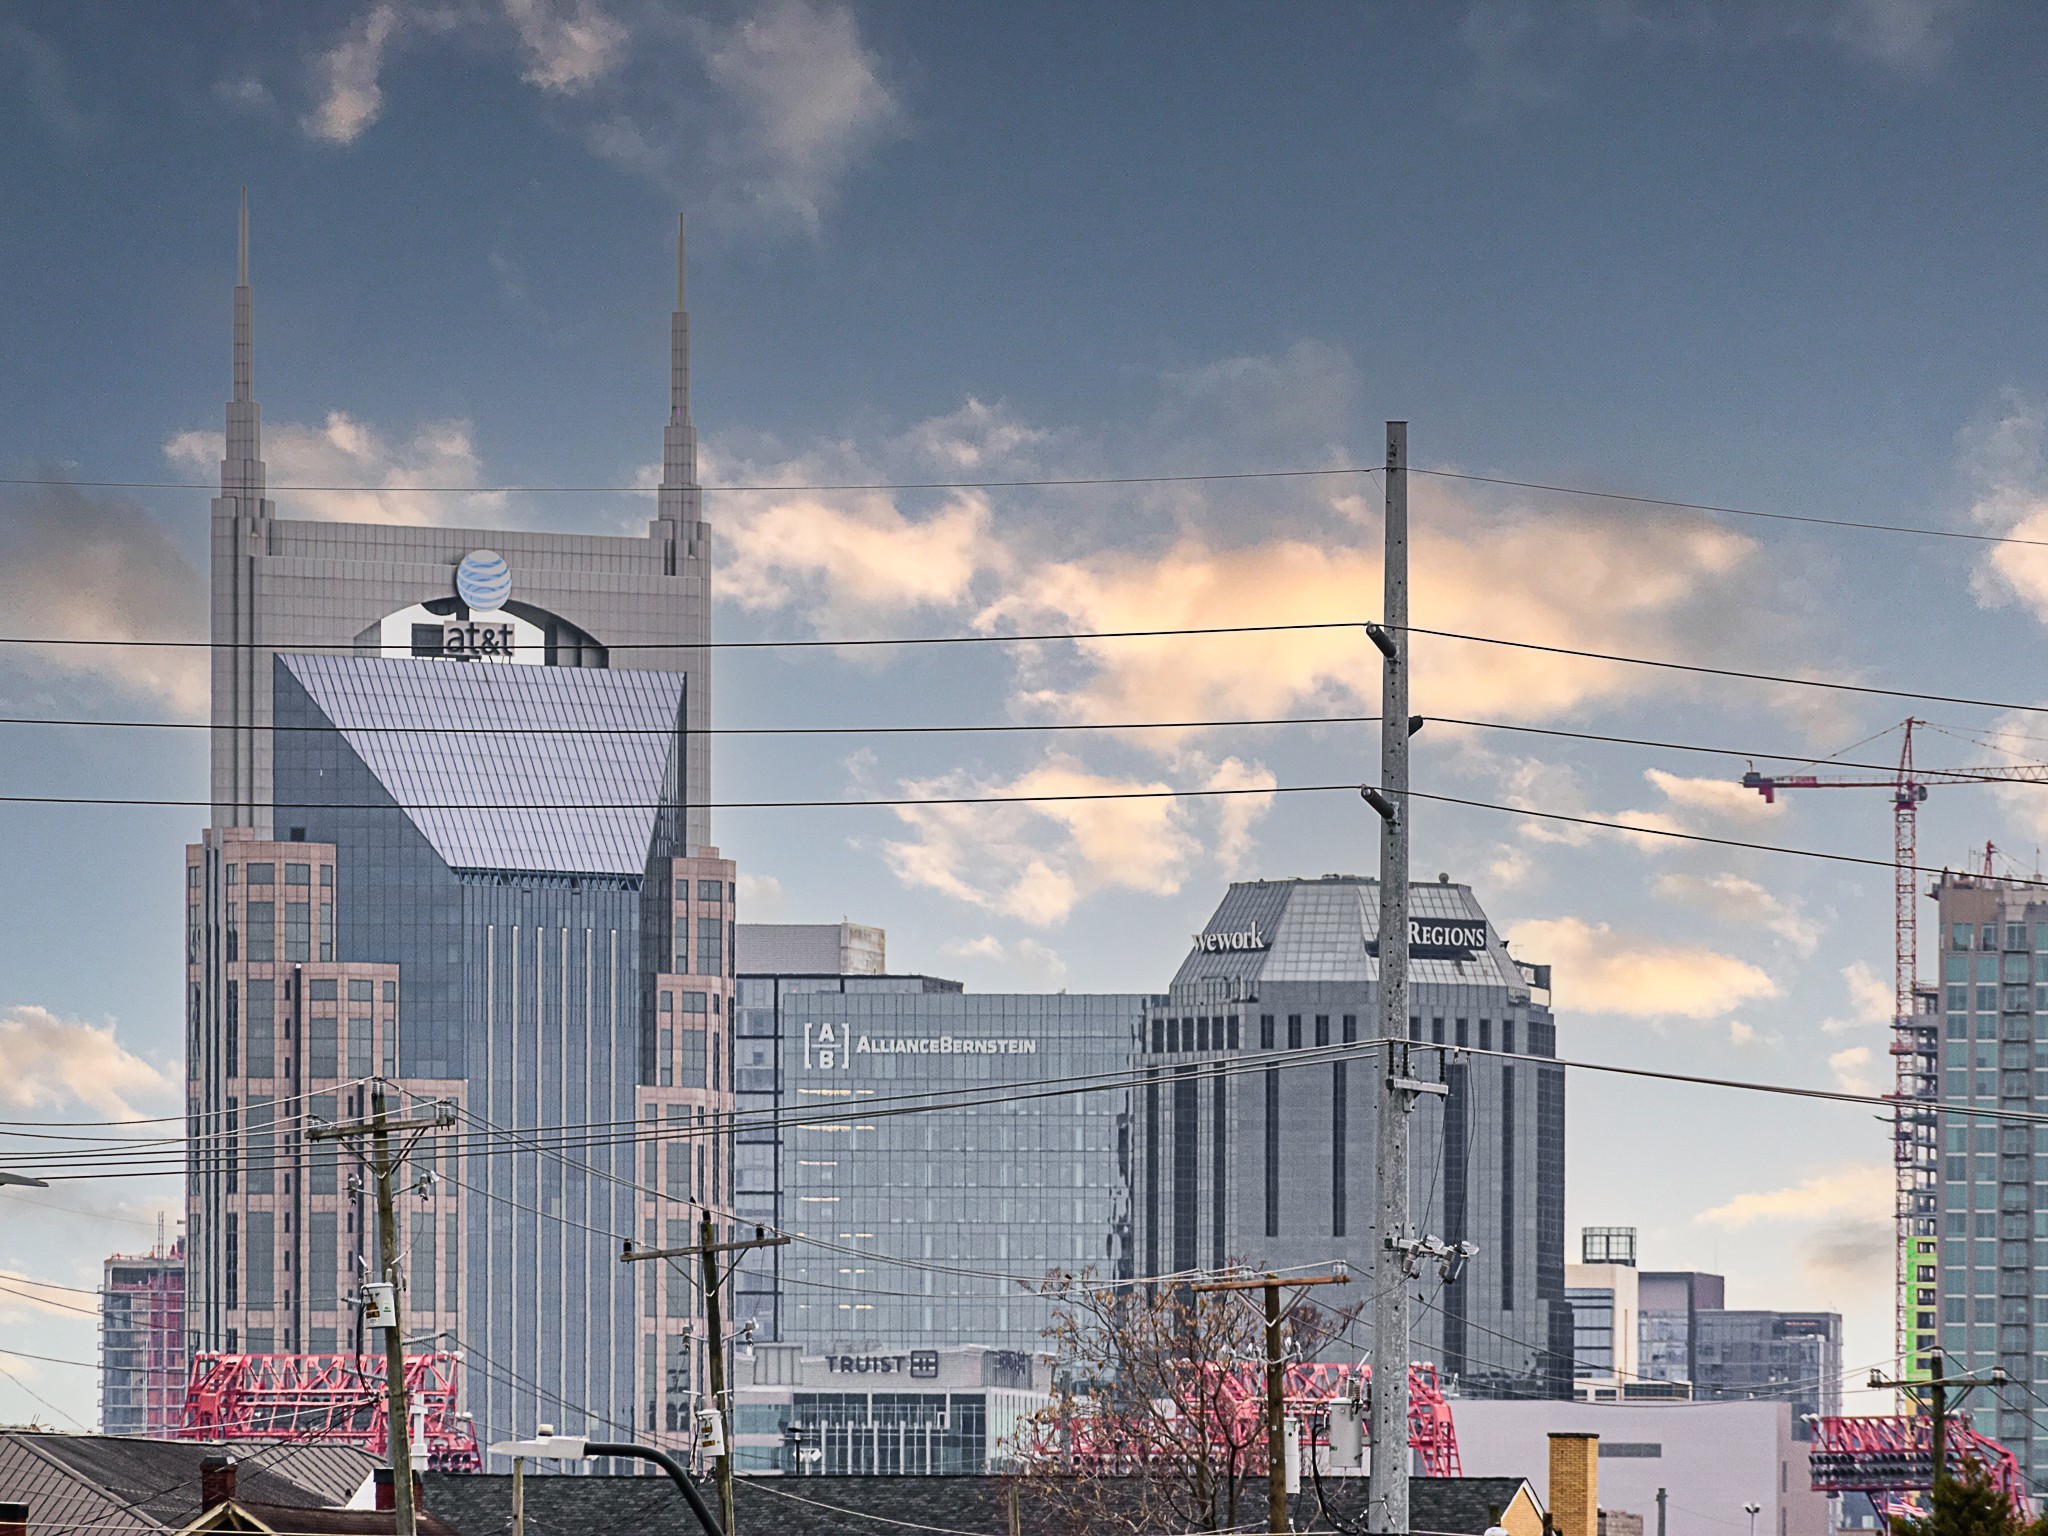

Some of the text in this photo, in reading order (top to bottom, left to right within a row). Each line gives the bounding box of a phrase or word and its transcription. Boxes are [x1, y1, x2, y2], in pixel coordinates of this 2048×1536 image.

[447, 622, 513, 656] at&t
[1191, 920, 1265, 951] wework
[1408, 921, 1485, 947] REGIONS
[856, 1036, 1036, 1054] ALLIANCEBERNSTEIN
[825, 1355, 906, 1373] TRUIST
